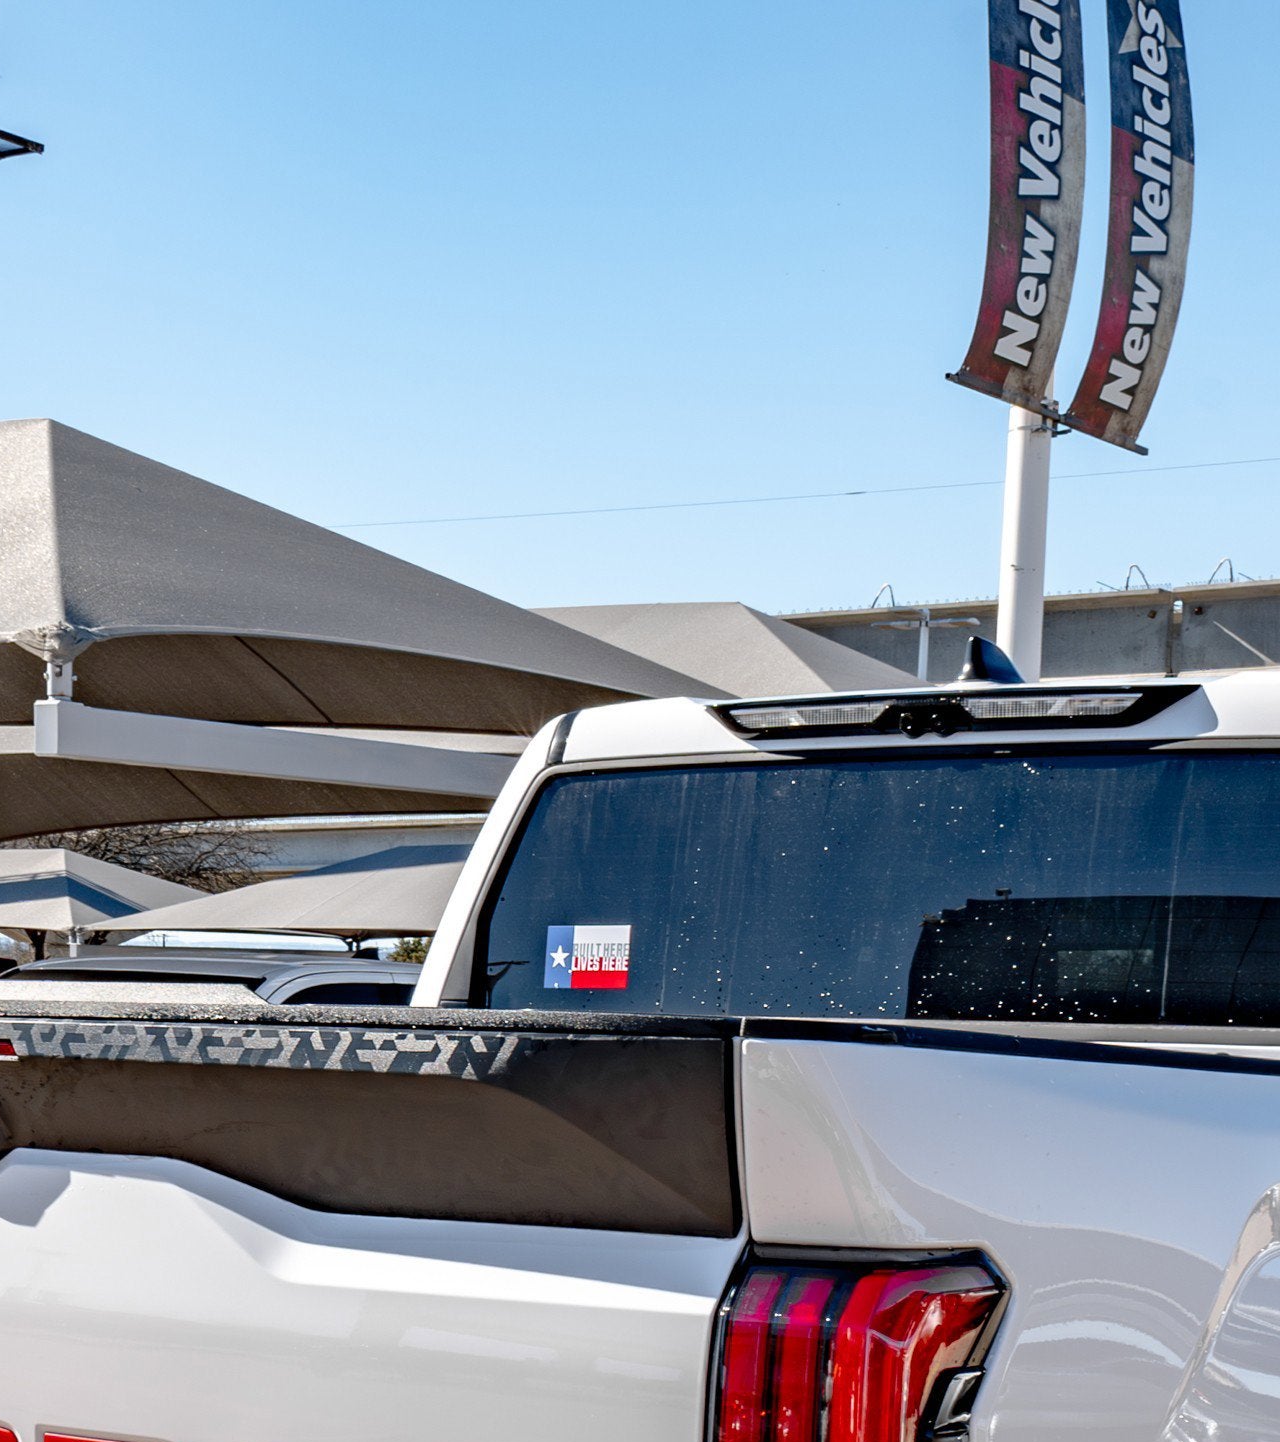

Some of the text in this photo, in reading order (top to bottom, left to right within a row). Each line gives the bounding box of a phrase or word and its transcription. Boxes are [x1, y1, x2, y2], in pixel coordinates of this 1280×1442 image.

[1099, 0, 1171, 410] New Vehicles
[994, 214, 1056, 367] New
[571, 957, 629, 971] LIVES HERE
[573, 942, 630, 957] BUILT HERE
